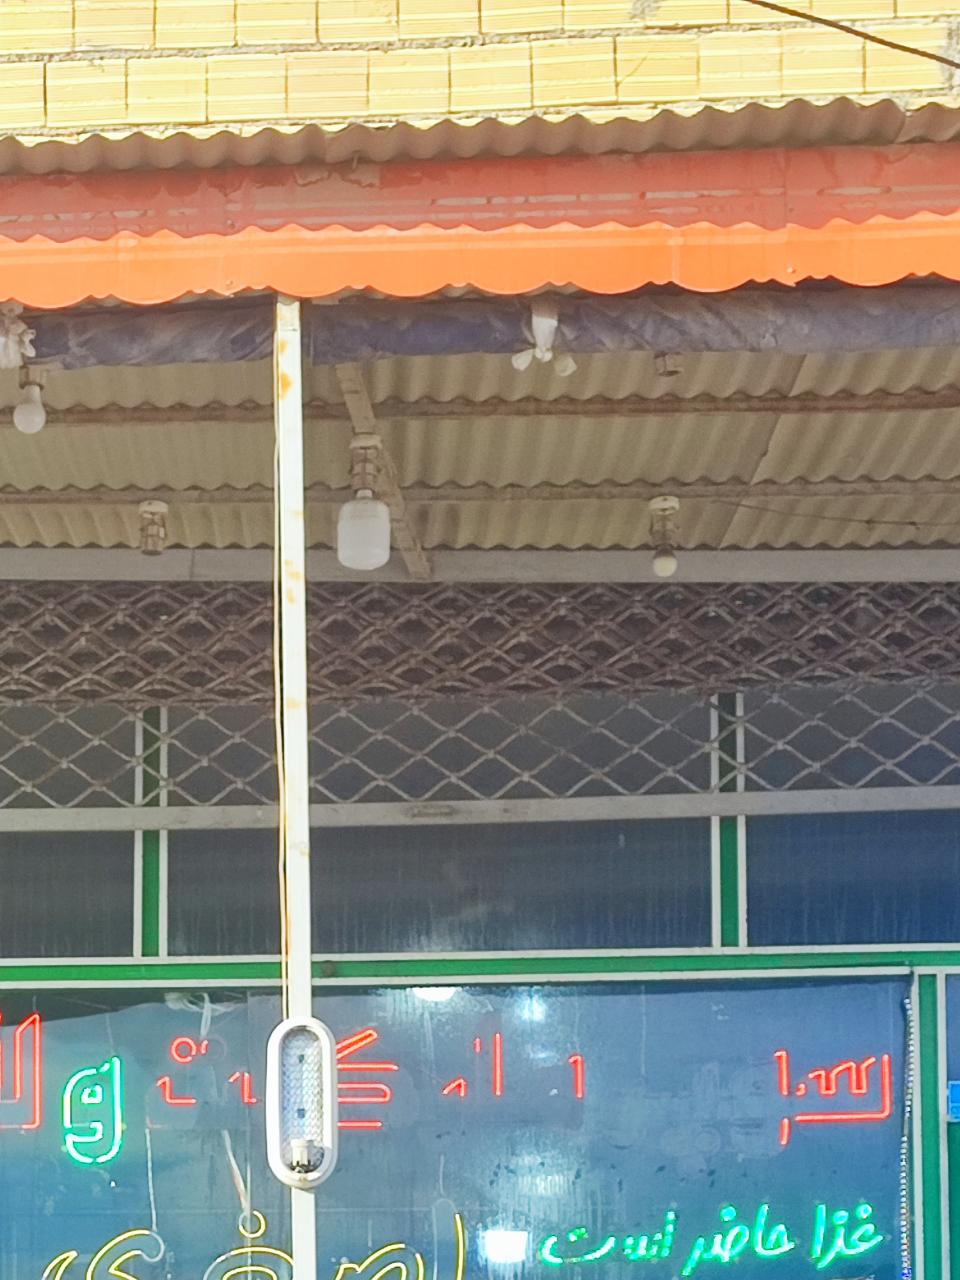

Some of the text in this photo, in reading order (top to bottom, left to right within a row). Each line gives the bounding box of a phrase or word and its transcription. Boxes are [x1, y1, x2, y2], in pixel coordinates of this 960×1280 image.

[62, 1054, 123, 1164] و
[540, 1202, 885, 1277] غذا حاضر است
